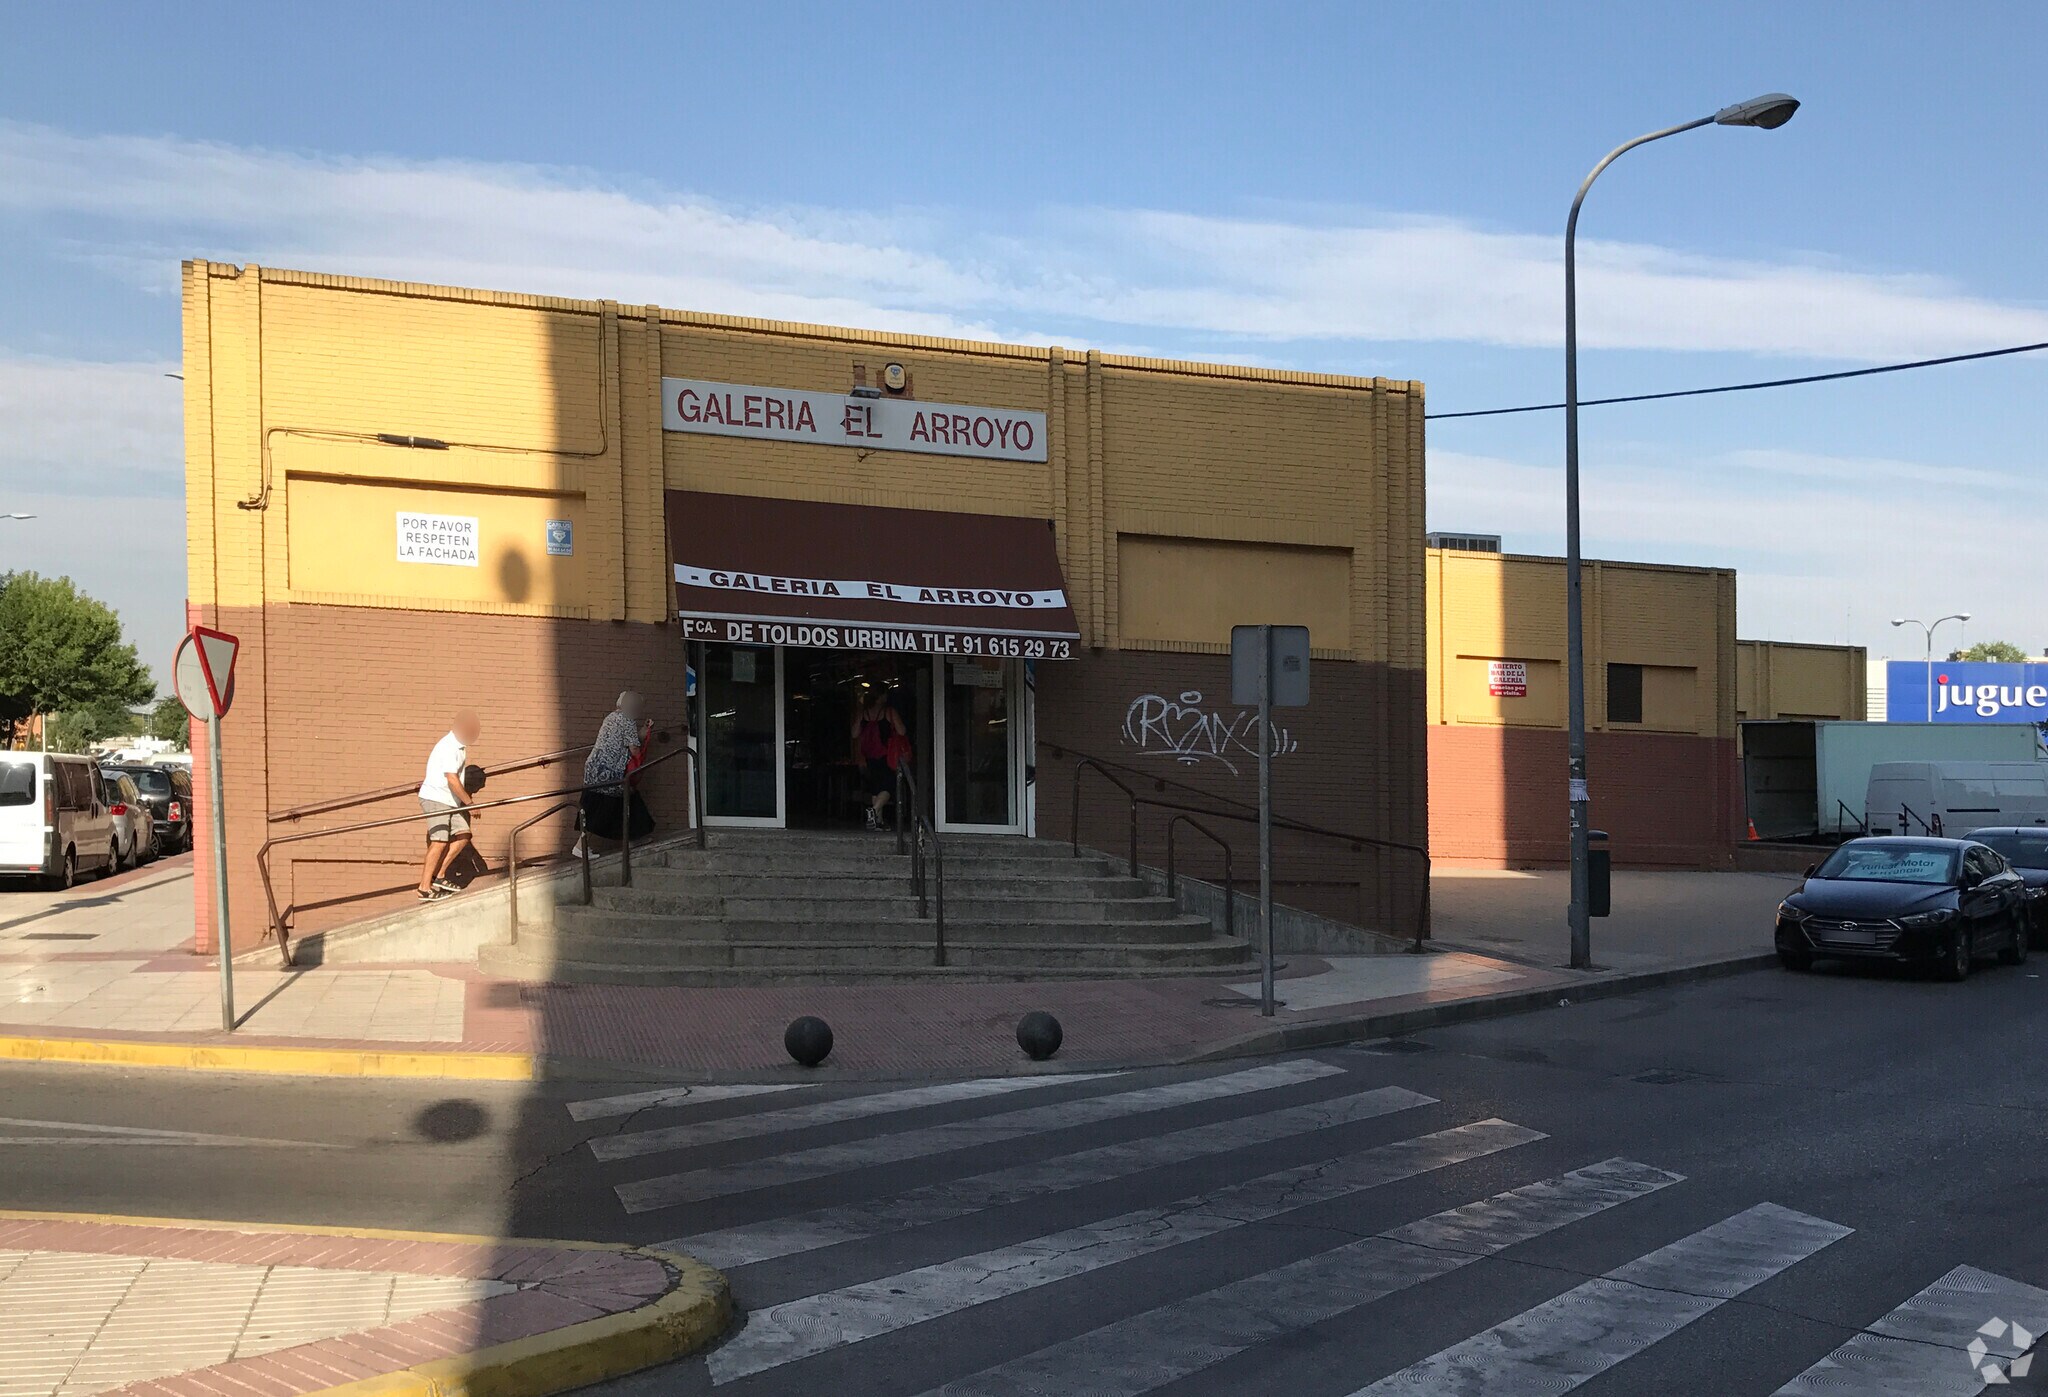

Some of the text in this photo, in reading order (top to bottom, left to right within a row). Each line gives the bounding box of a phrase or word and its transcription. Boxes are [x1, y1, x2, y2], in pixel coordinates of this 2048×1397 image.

[677, 389, 1034, 452] GALERIA EL ARROYO
[402, 518, 472, 533] POR FAVOR
[406, 532, 470, 546] RESPETEN
[399, 546, 476, 560] LA FACHADA
[709, 572, 840, 596] GALERIA
[866, 583, 902, 600] EL
[918, 588, 1034, 607] ARROYO
[726, 622, 754, 642] DE
[758, 624, 839, 648] TOLDOS
[844, 628, 918, 651] URBINA
[921, 633, 958, 653] TLF.
[962, 636, 982, 654] 91
[988, 637, 1019, 656] 615
[1023, 639, 1045, 657] 29
[1049, 641, 1070, 659] 73
[1936, 674, 2048, 717] jugue
[1900, 859, 1936, 868] Motor
